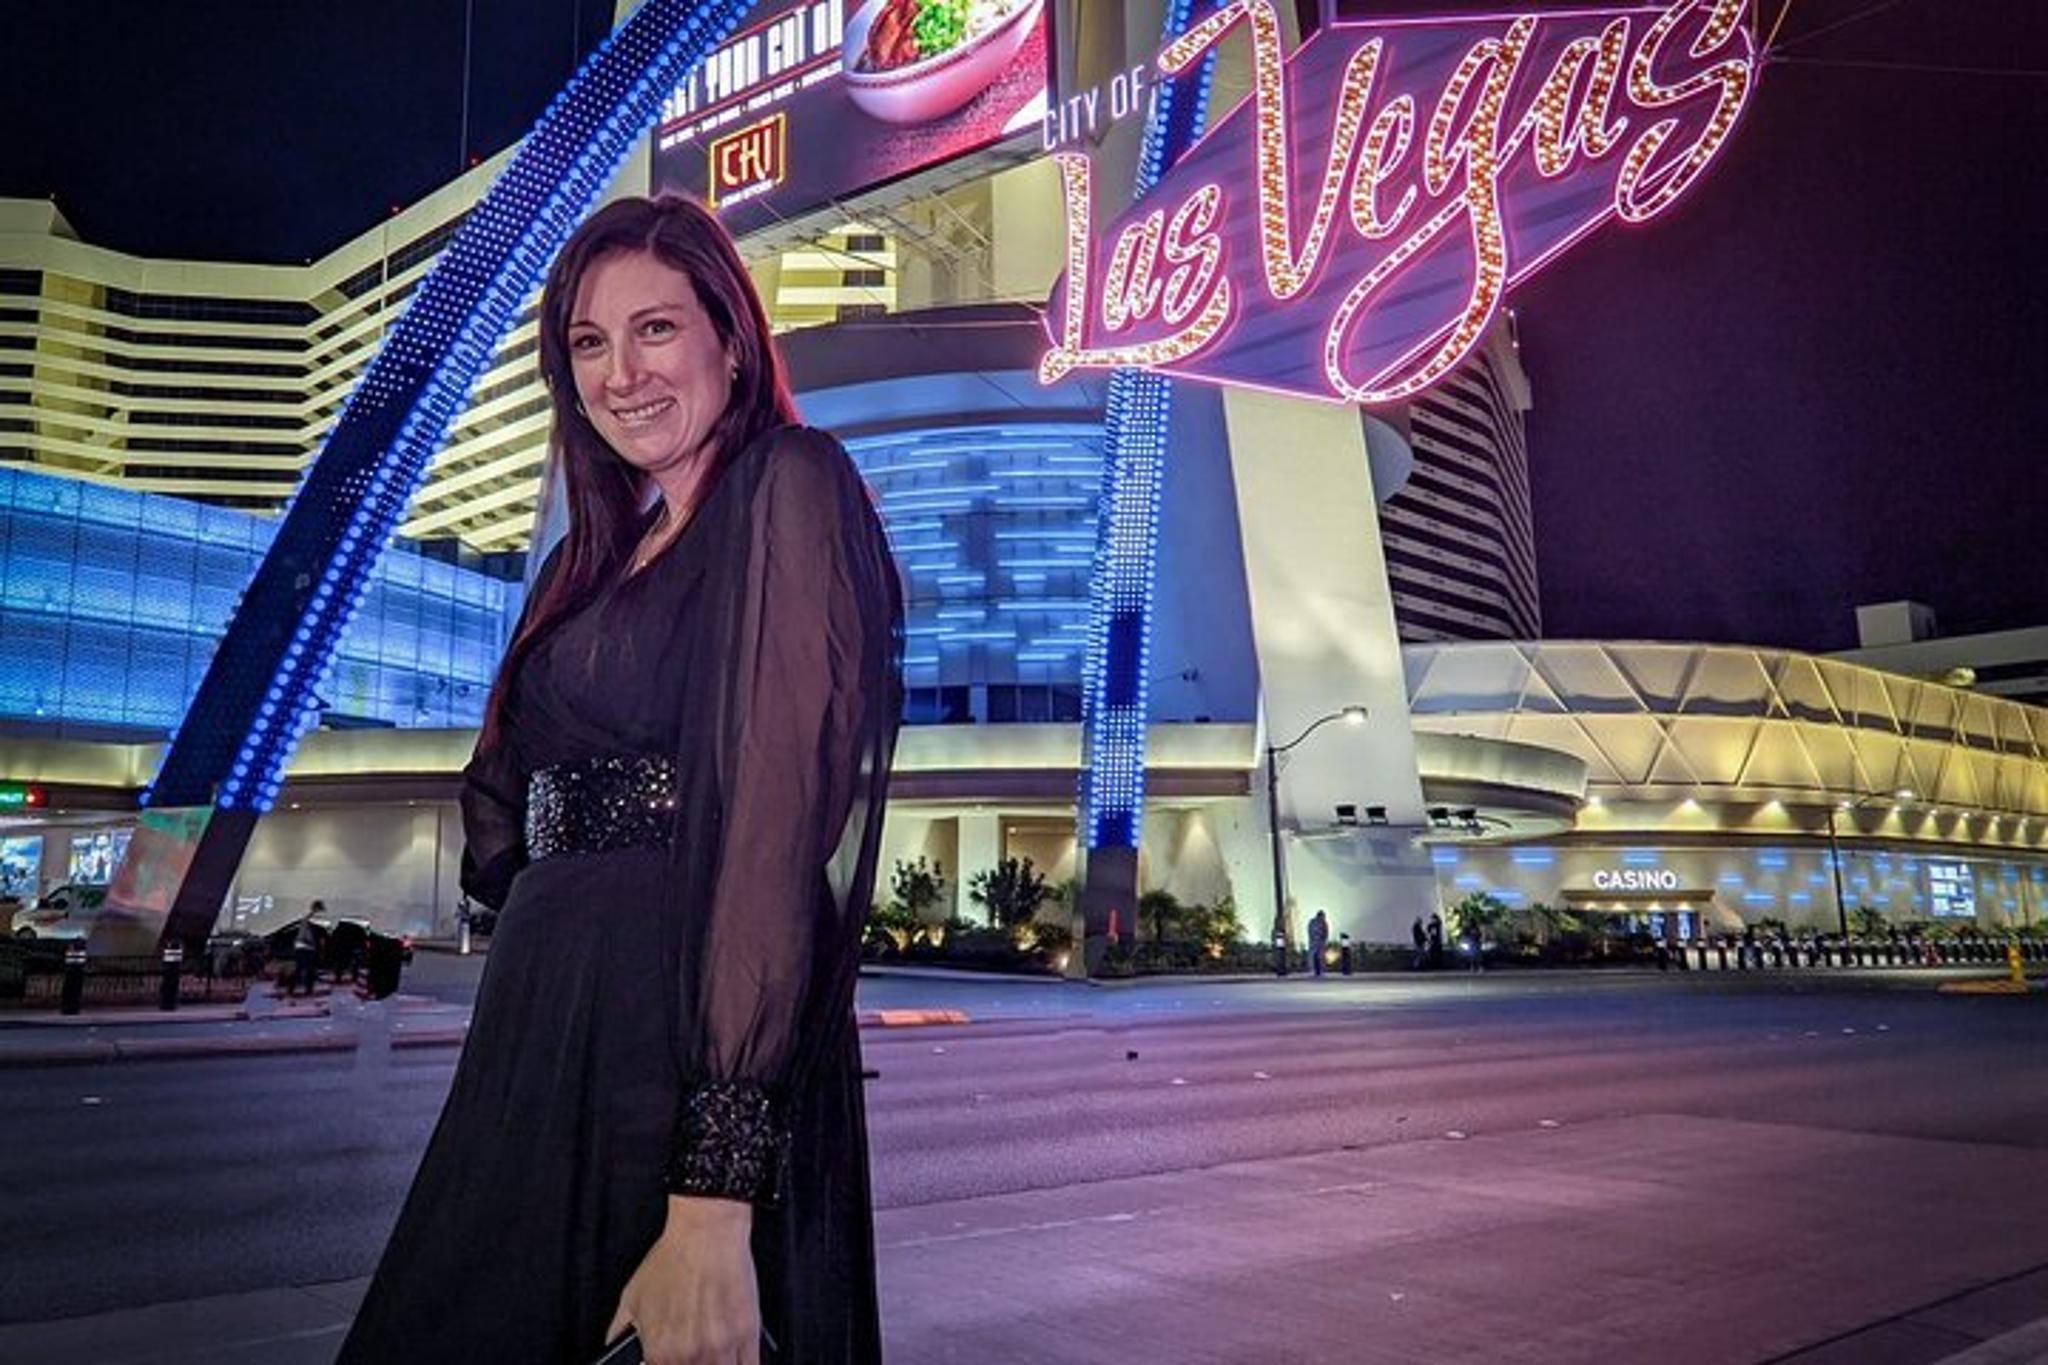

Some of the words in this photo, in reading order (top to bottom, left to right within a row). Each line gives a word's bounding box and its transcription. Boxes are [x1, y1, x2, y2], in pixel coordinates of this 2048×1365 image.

[1043, 85, 1099, 152] CITY
[1111, 64, 1145, 119] OF
[721, 127, 772, 186] CHI
[1038, 150, 1233, 385] Las
[1157, 0, 1752, 402] Vegas
[1592, 869, 1677, 890] CASINO
